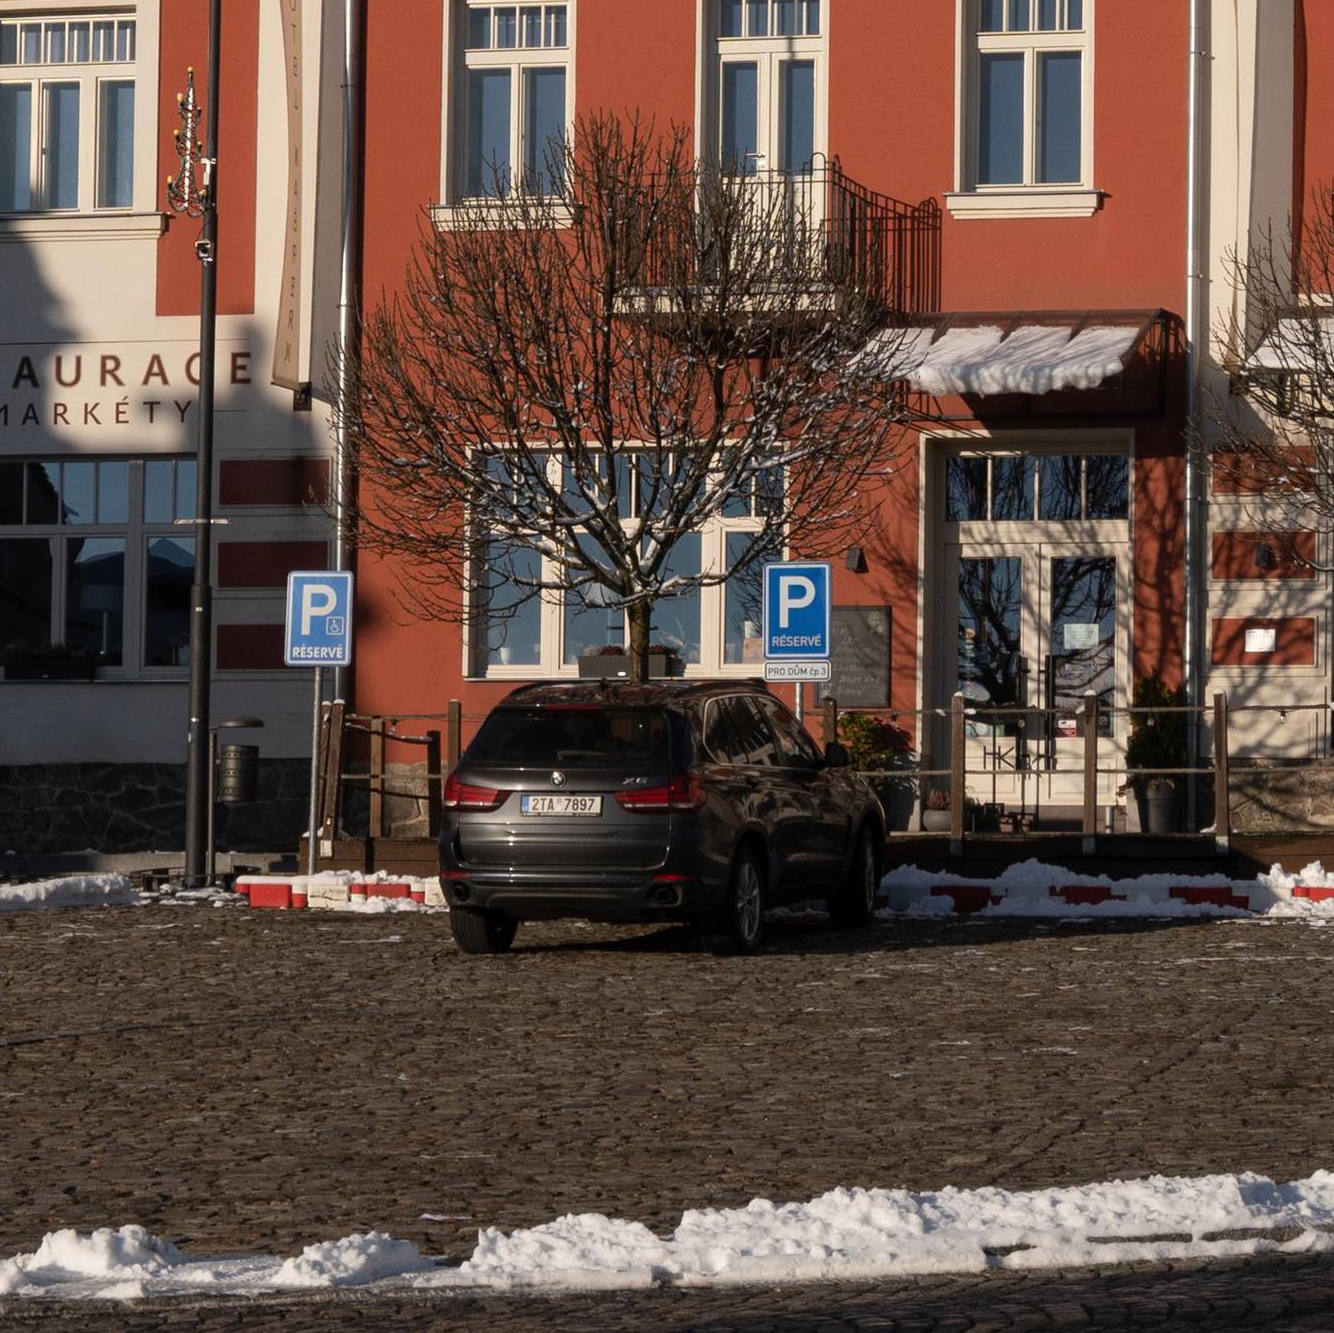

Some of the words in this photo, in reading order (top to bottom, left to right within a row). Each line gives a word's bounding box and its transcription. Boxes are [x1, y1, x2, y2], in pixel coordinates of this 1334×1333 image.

[779, 575, 816, 629] P
[301, 584, 337, 636] P
[772, 634, 822, 647] RÉSERVÉ
[292, 643, 344, 659] RÉSERVÉ
[768, 667, 786, 676] PRO
[788, 665, 808, 676] DŮM
[809, 666, 827, 678] čp.3
[531, 798, 554, 811] 2TA
[564, 798, 596, 812] 7897
